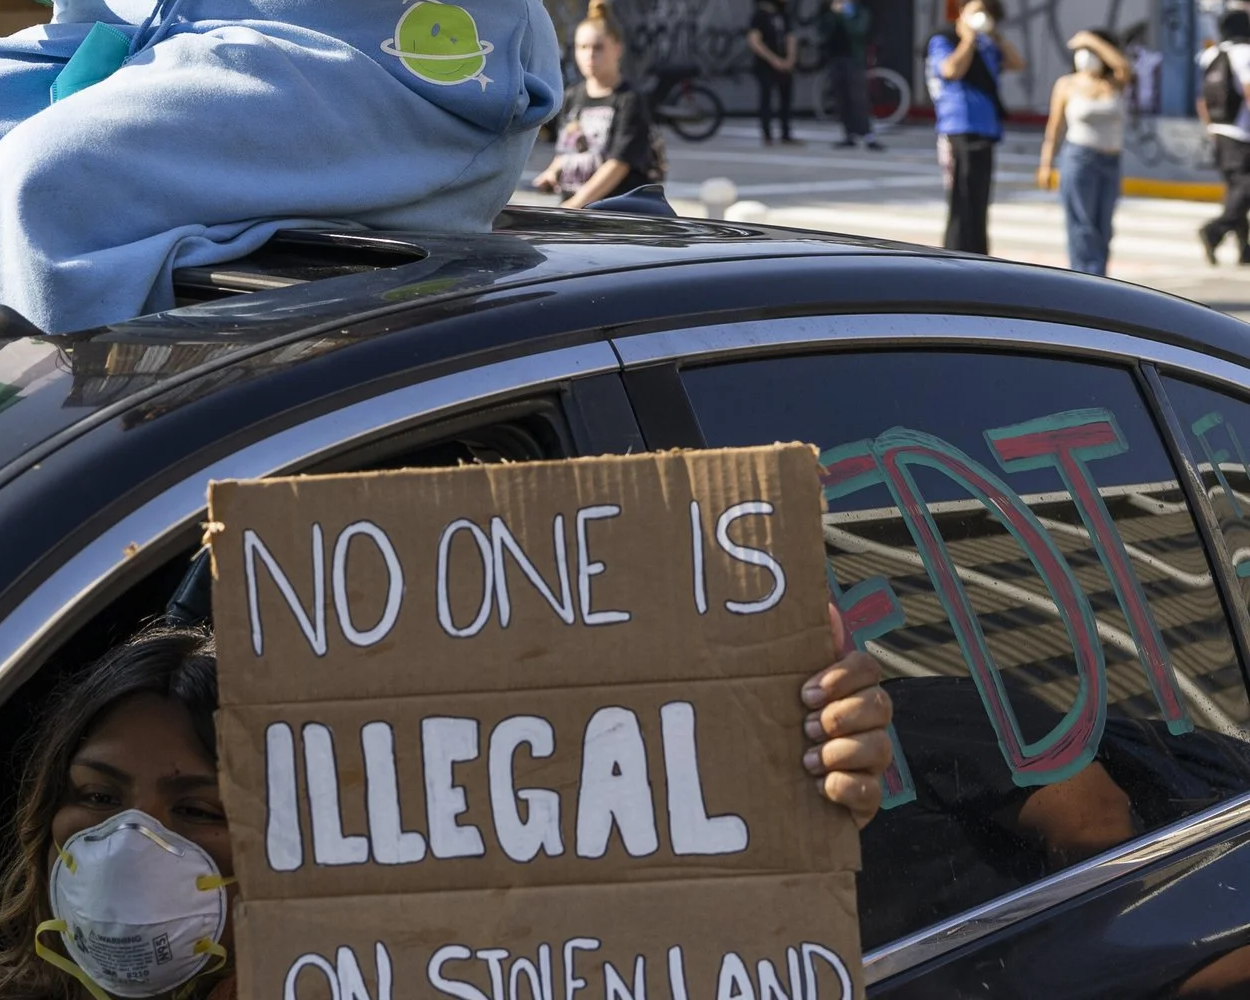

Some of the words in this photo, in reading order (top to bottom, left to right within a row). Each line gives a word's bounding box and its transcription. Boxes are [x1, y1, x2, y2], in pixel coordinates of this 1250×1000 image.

[243, 519, 405, 657] NO
[435, 504, 632, 639] ONE
[689, 499, 787, 615] IS
[264, 700, 750, 872] ILLEGAL
[155, 938, 170, 962] N95
[282, 940, 393, 1000] ON
[427, 937, 647, 1000] STOLEN
[667, 941, 854, 1000] LAND
